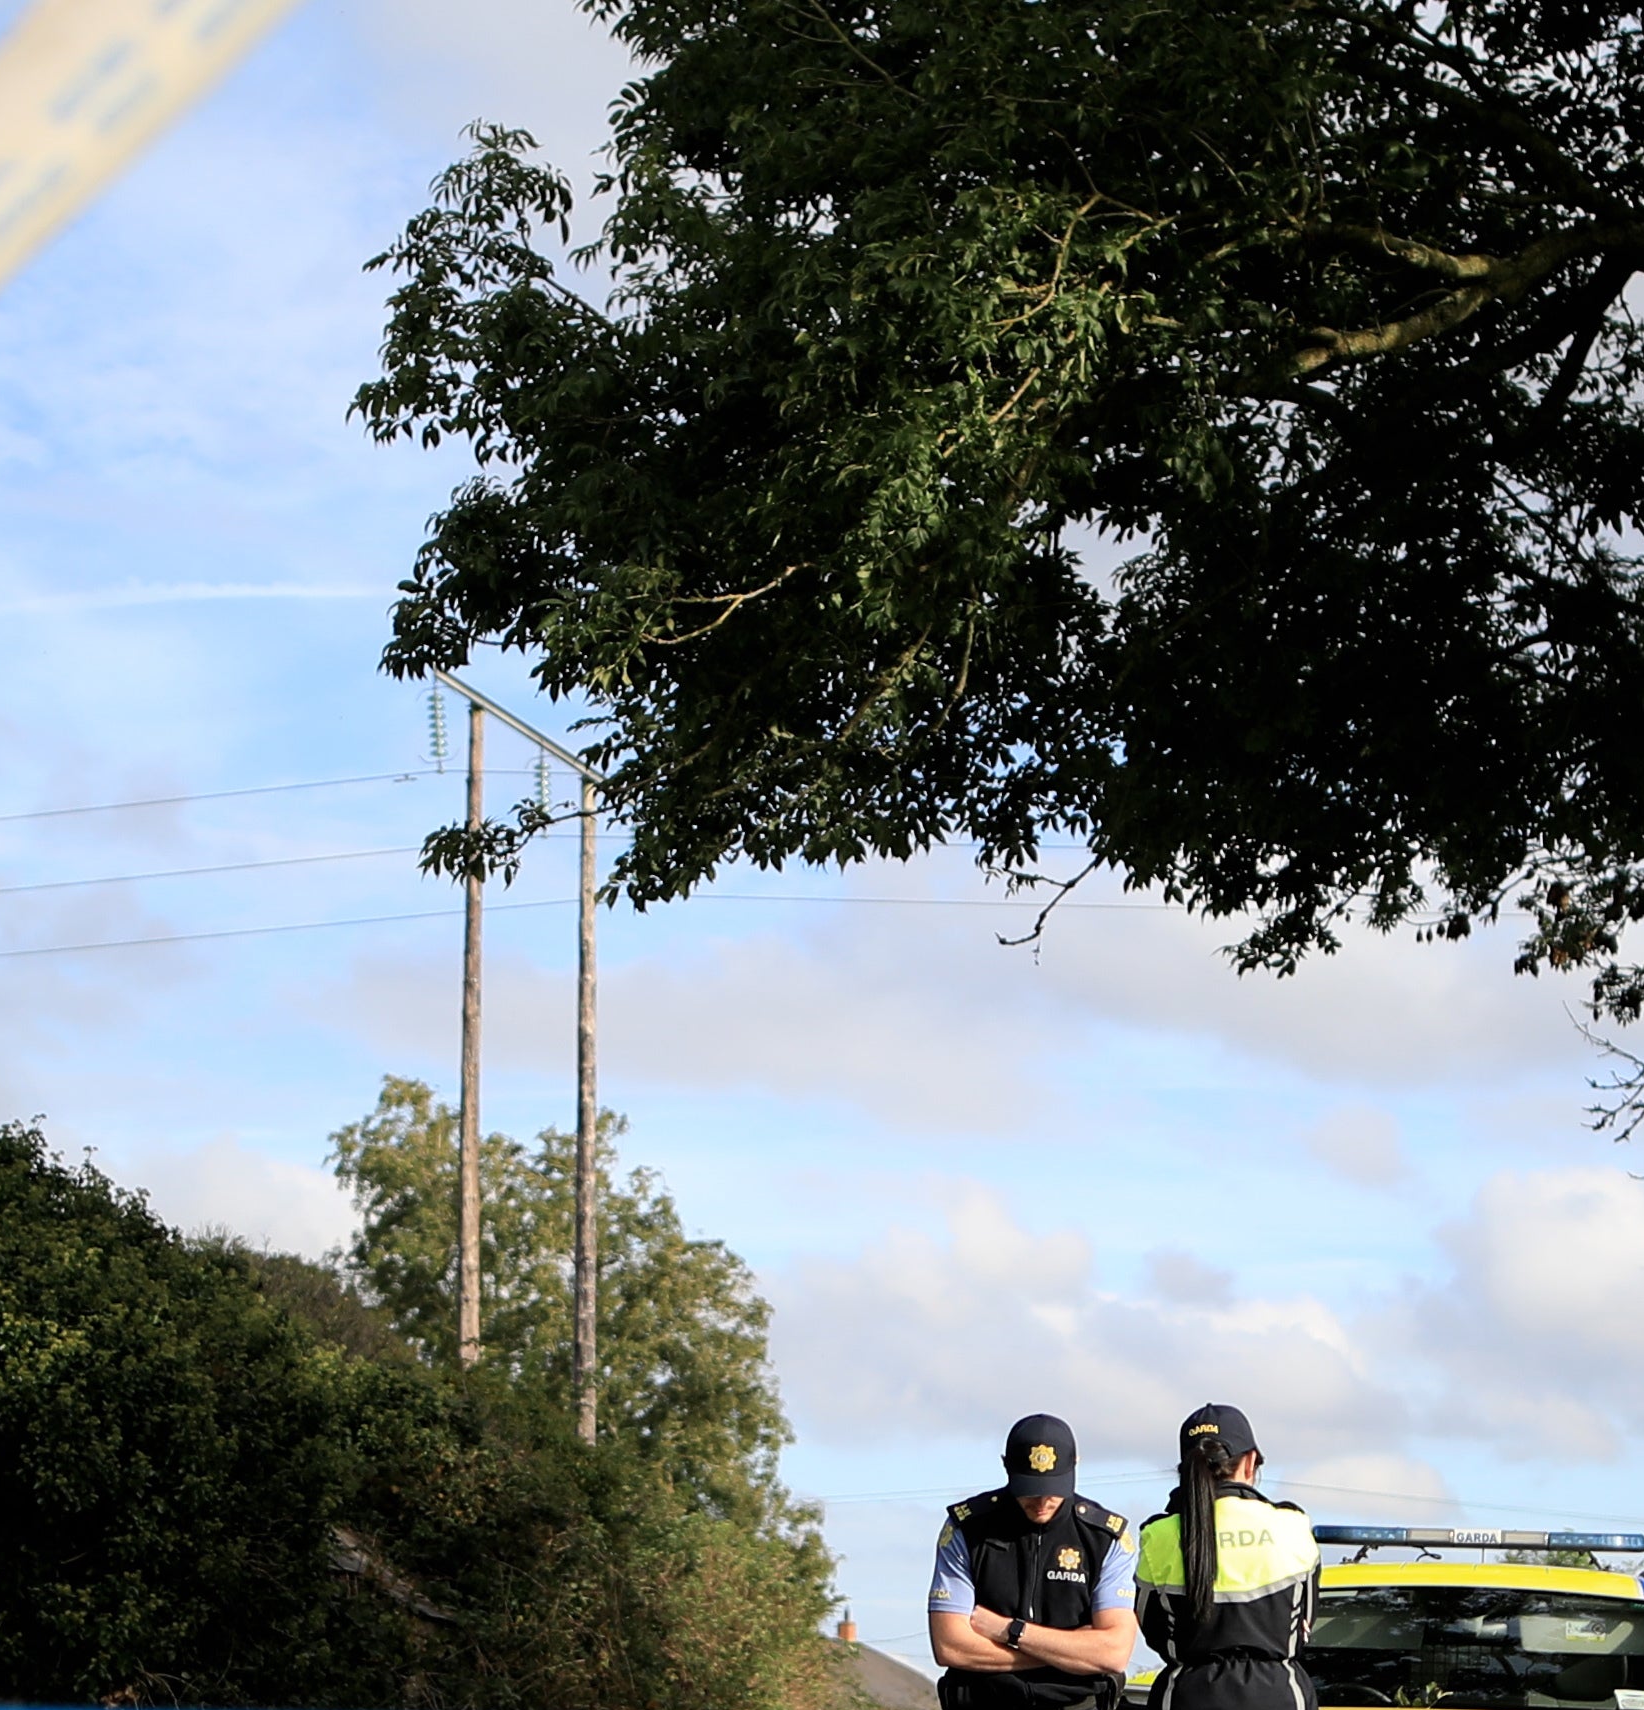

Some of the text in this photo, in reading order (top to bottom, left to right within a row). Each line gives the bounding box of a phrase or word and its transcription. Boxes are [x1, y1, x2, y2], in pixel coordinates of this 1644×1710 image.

[1219, 1529, 1274, 1549] RDA
[1456, 1532, 1497, 1543] GARDA
[1046, 1570, 1086, 1583] GARDA
